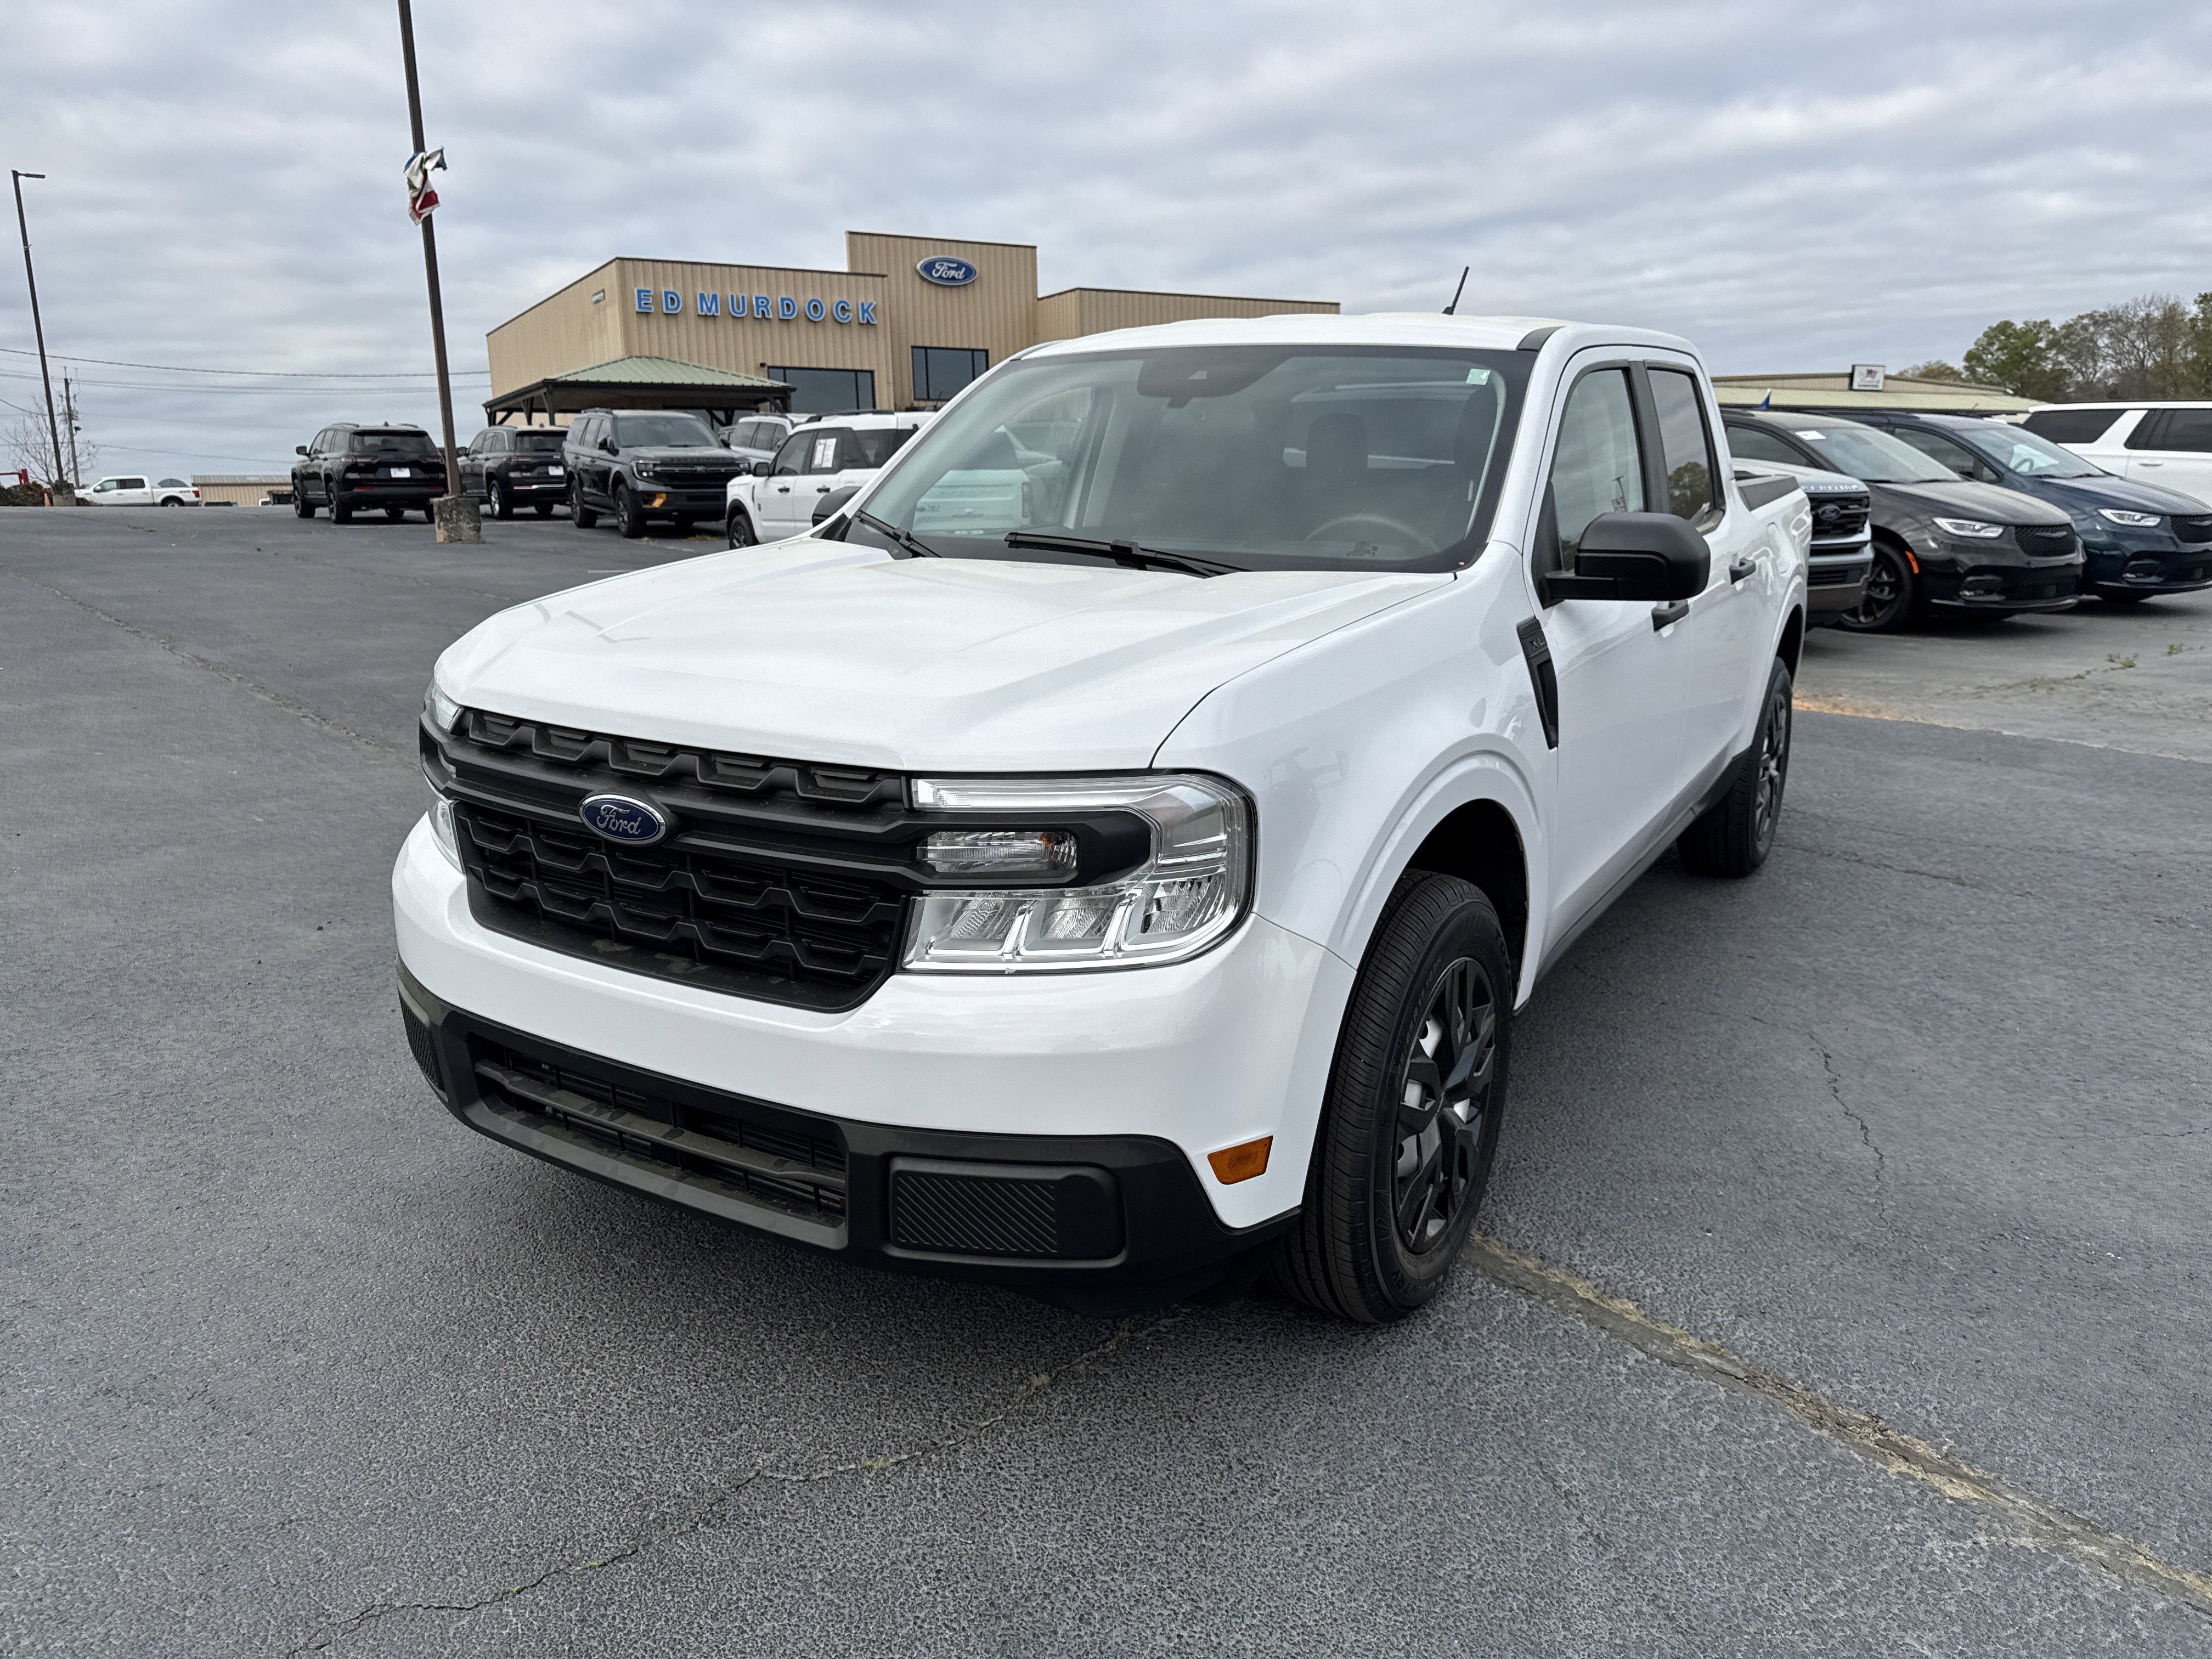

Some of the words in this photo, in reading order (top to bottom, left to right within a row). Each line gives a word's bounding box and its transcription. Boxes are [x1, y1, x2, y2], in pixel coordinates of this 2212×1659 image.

[932, 261, 966, 280] Ford
[635, 287, 682, 314] ED
[697, 292, 878, 324] MURDOCK
[1530, 637, 1546, 650] XL
[596, 804, 642, 835] Ford
